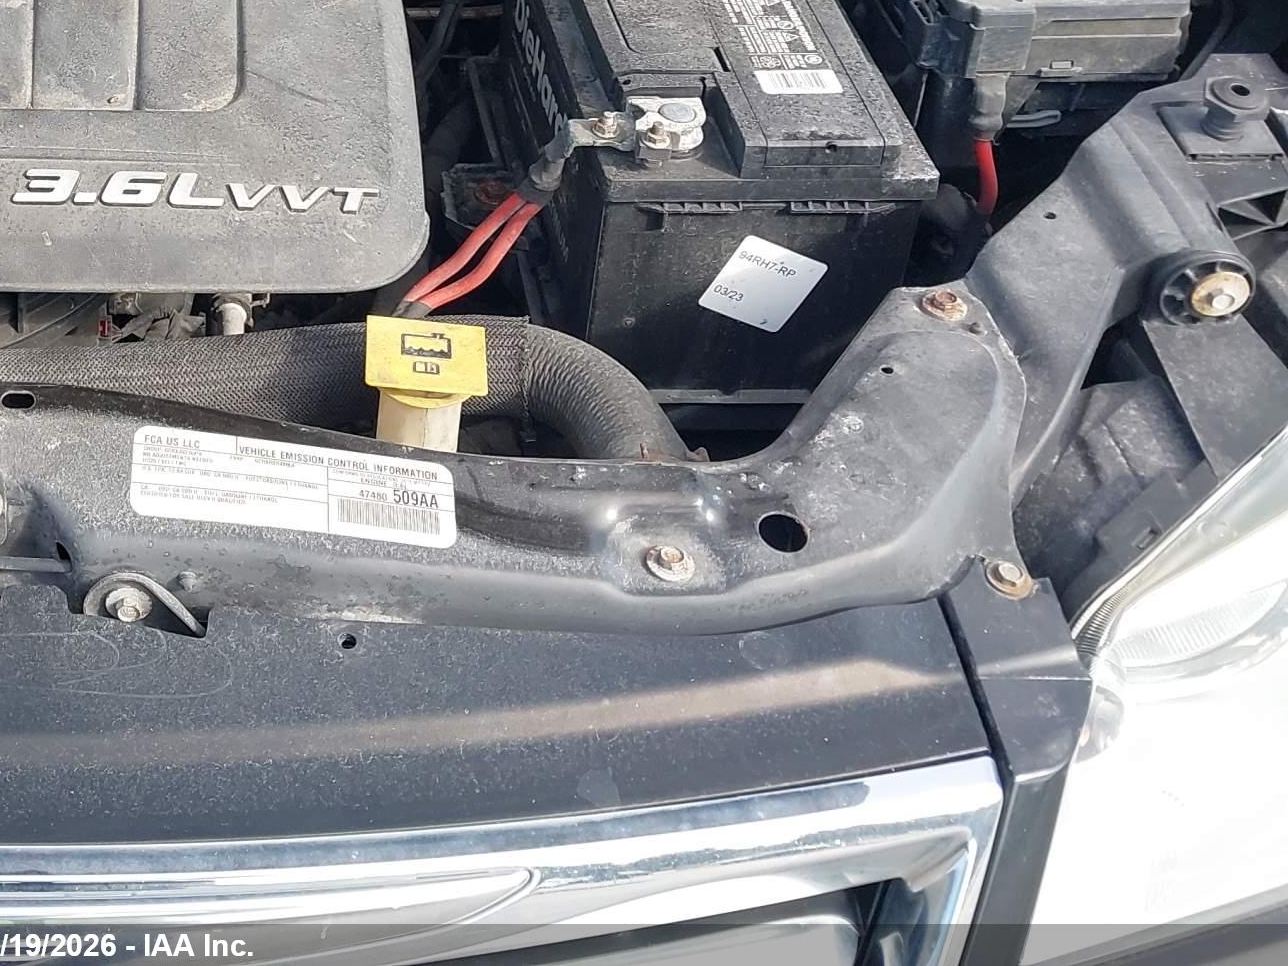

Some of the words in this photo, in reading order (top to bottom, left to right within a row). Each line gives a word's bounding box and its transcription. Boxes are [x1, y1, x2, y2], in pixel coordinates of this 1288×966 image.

[11, 168, 225, 210] 3.6L
[226, 181, 381, 215] VVT
[738, 250, 797, 278] 94RH7-RP
[713, 284, 745, 303] 03/23
[144, 434, 164, 446] FCA
[165, 436, 181, 448] US
[182, 438, 201, 449] LLC
[239, 445, 276, 459] VEHICLE
[279, 450, 325, 465] EMISSION
[327, 456, 369, 471] CONTROL
[373, 463, 439, 481] INFORMATION
[392, 489, 439, 509] 509AA
